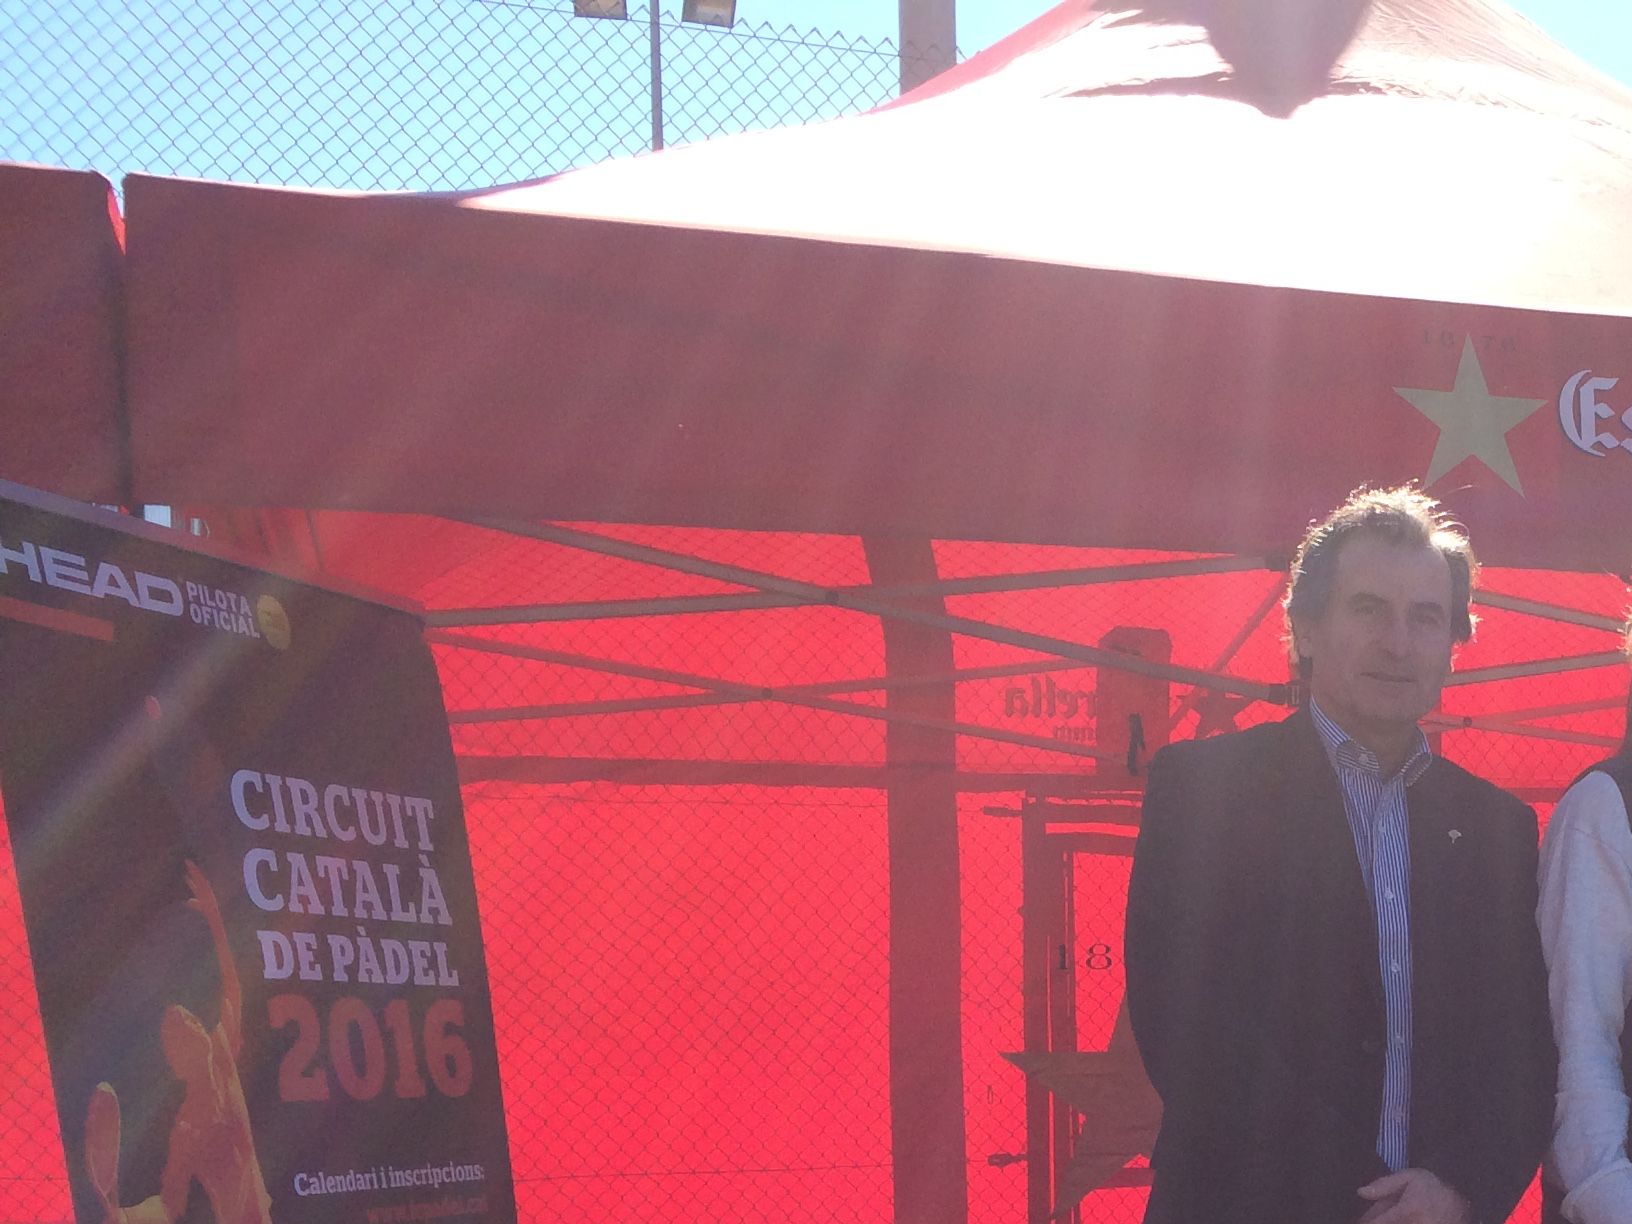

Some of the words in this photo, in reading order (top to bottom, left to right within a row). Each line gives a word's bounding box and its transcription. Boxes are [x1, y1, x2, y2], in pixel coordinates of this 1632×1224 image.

[0, 536, 184, 617] HEAD
[186, 580, 253, 617] PILOTA
[190, 606, 261, 639] OFICIAL
[229, 768, 434, 852] CIRCUIT
[242, 848, 453, 926] CATALÀ
[259, 930, 322, 981] DE
[329, 926, 459, 987] PÀDEL
[269, 996, 472, 1100] 2016
[294, 1167, 379, 1197] Calendari
[380, 1166, 388, 1189] i
[388, 1161, 485, 1188] inscripcions:
